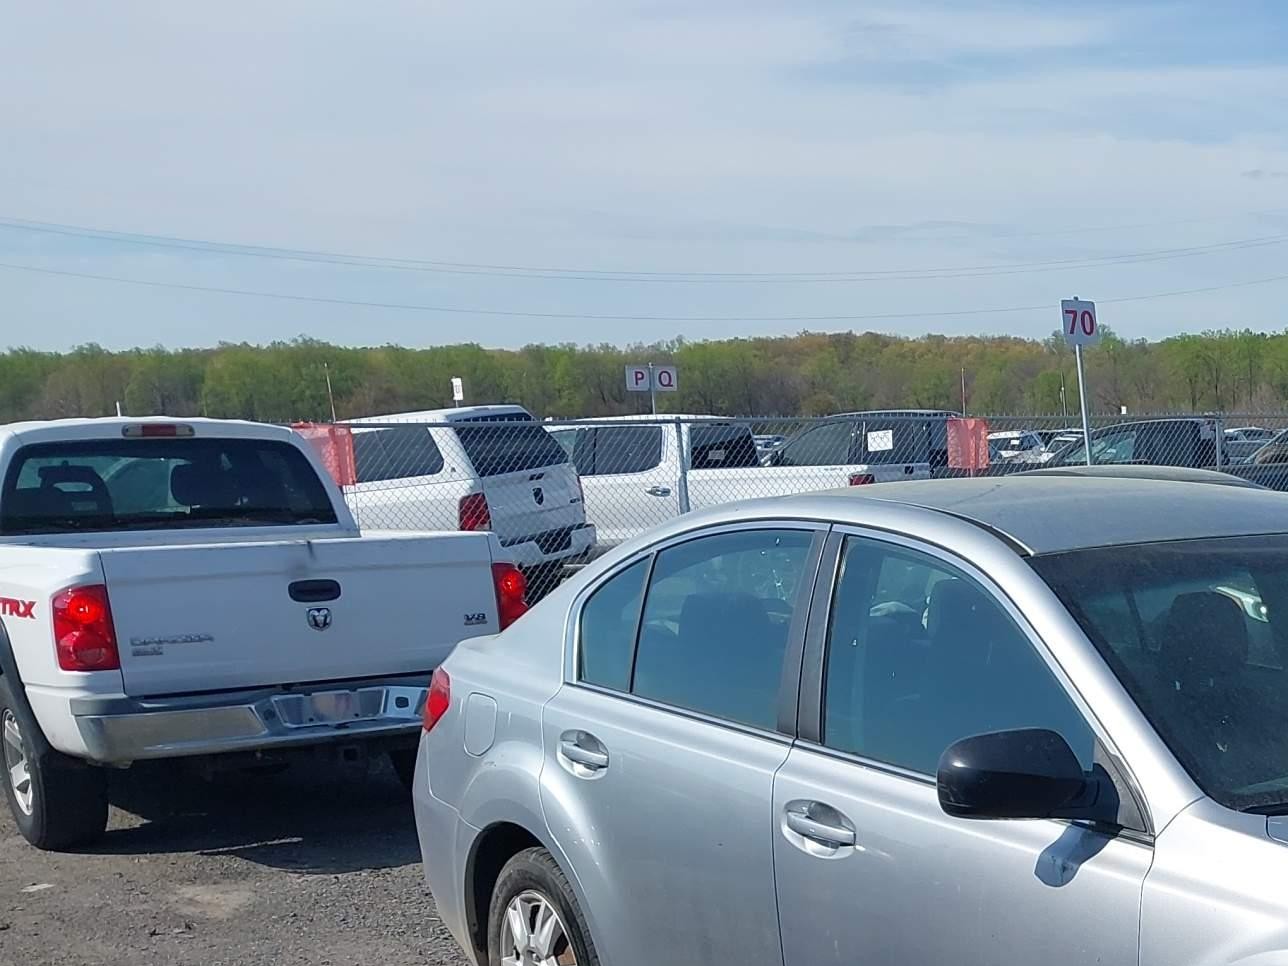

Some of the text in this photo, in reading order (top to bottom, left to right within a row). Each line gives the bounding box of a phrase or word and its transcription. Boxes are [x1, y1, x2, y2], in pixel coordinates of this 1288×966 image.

[1064, 309, 1094, 336] 70
[634, 370, 674, 388] P Q
